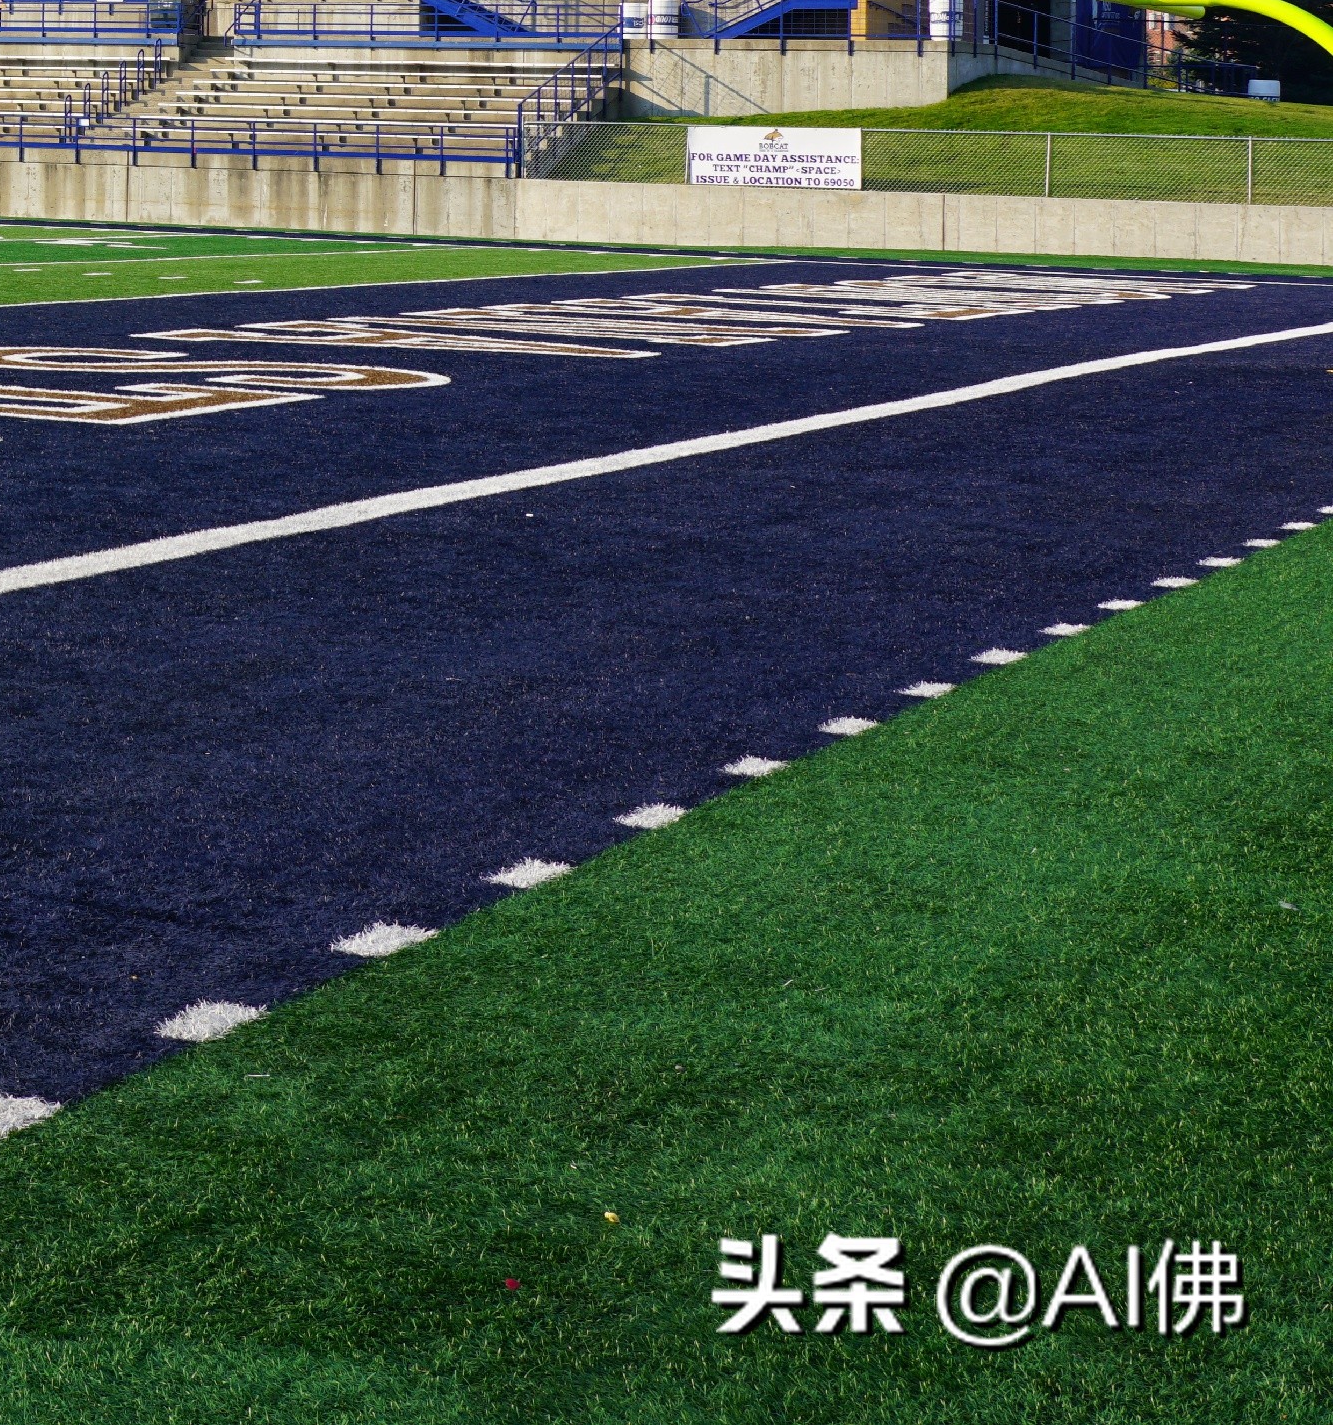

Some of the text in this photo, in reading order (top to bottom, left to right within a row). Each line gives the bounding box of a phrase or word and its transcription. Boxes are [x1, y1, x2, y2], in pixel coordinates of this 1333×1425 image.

[690, 153, 859, 164] FOR GAME DAY ASSISTANCE:
[713, 164, 740, 172] TEXT
[695, 175, 730, 184] ISSUE
[743, 176, 802, 186] LOCATION
[805, 177, 821, 186] TO
[823, 178, 855, 187] 69050
